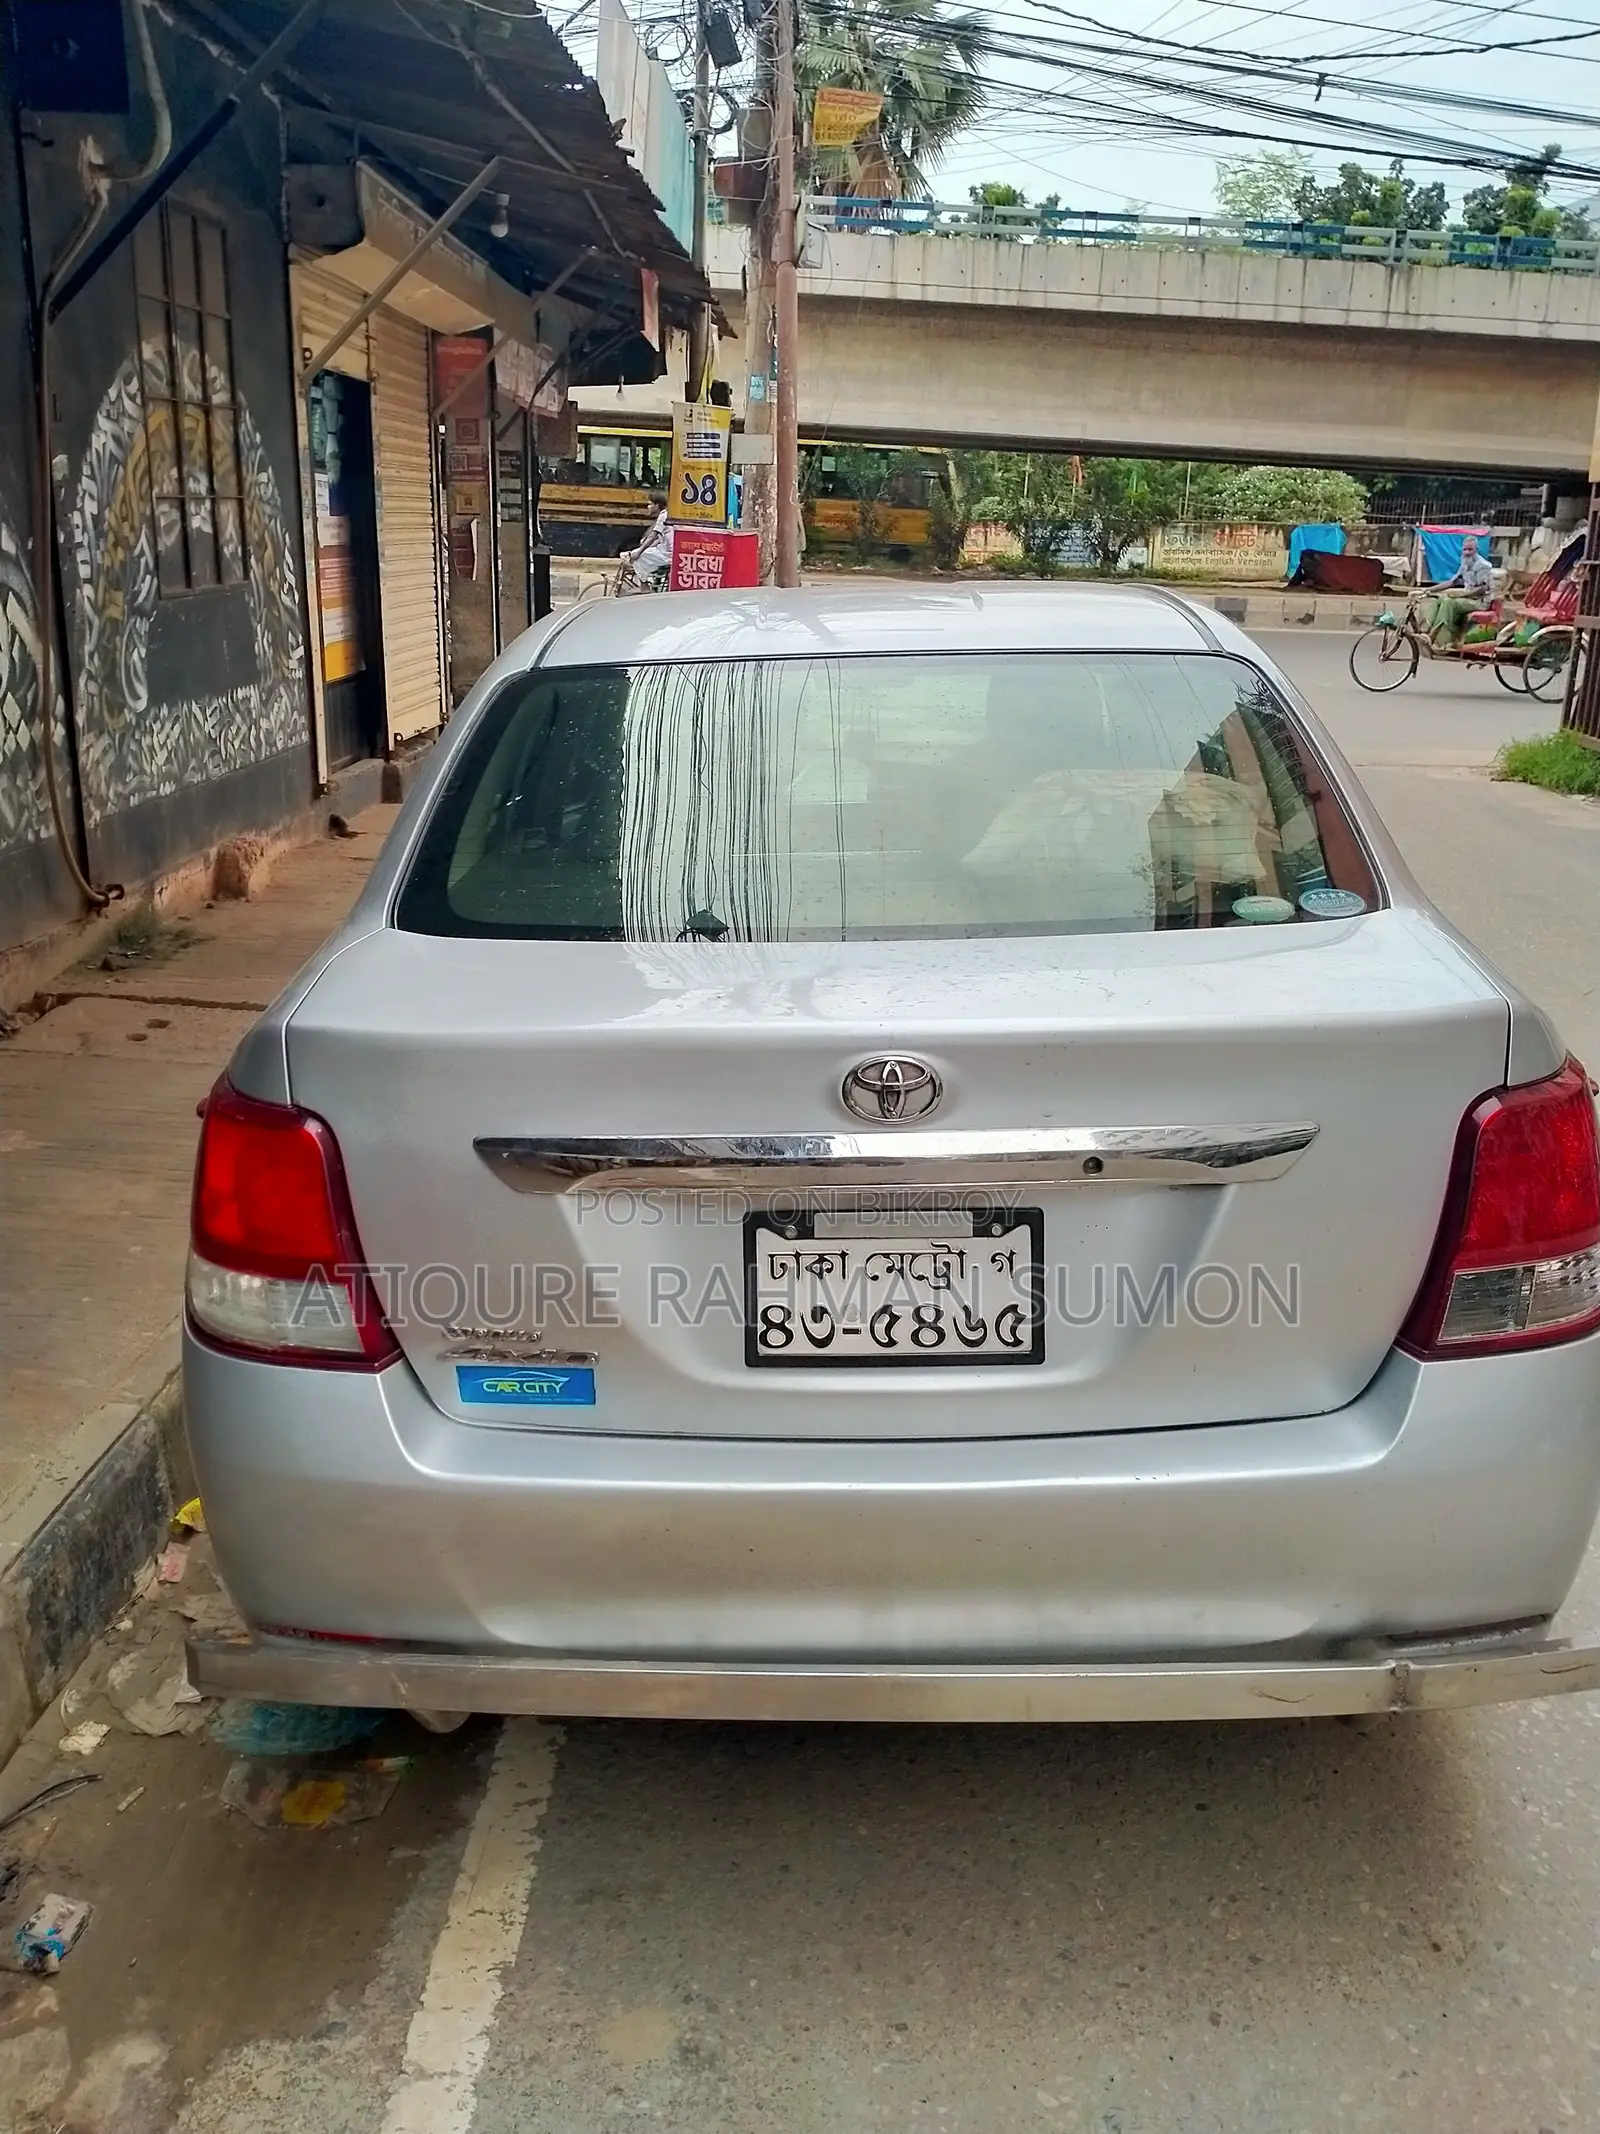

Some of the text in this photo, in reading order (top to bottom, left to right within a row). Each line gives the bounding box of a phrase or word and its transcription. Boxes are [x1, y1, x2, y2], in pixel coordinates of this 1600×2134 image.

[681, 472, 717, 505] ১৪
[678, 549, 725, 573] সুবিধা
[1205, 556, 1234, 566] English
[677, 571, 722, 588] ডাবল
[767, 1248, 851, 1281] ঢাকা
[990, 1248, 1018, 1281] গ
[758, 1302, 1029, 1349] ৪৩-৫৪৬৫
[482, 1380, 566, 1394] CAR CITY
